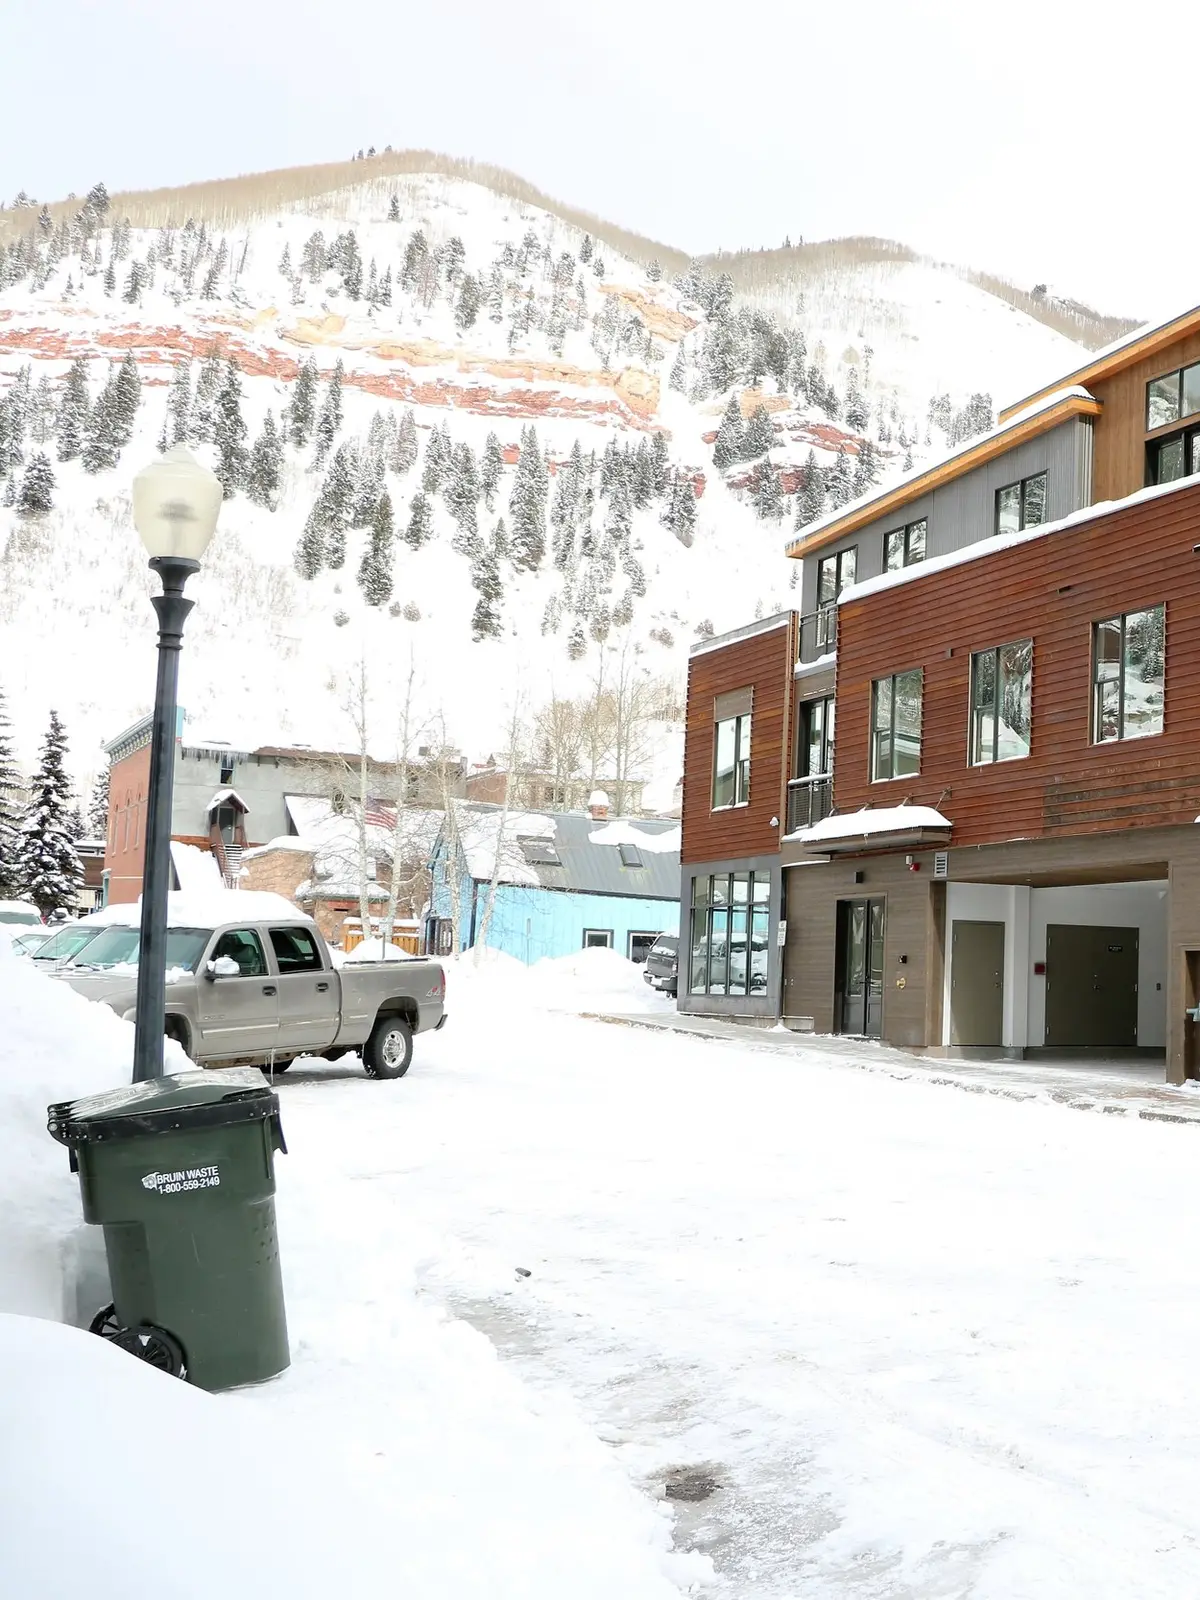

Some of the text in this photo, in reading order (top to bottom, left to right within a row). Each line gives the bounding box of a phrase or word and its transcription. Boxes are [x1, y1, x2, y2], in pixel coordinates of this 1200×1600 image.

[157, 1165, 219, 1184] BRUIN WASTE
[158, 1176, 220, 1194] 1-800-559-2149
